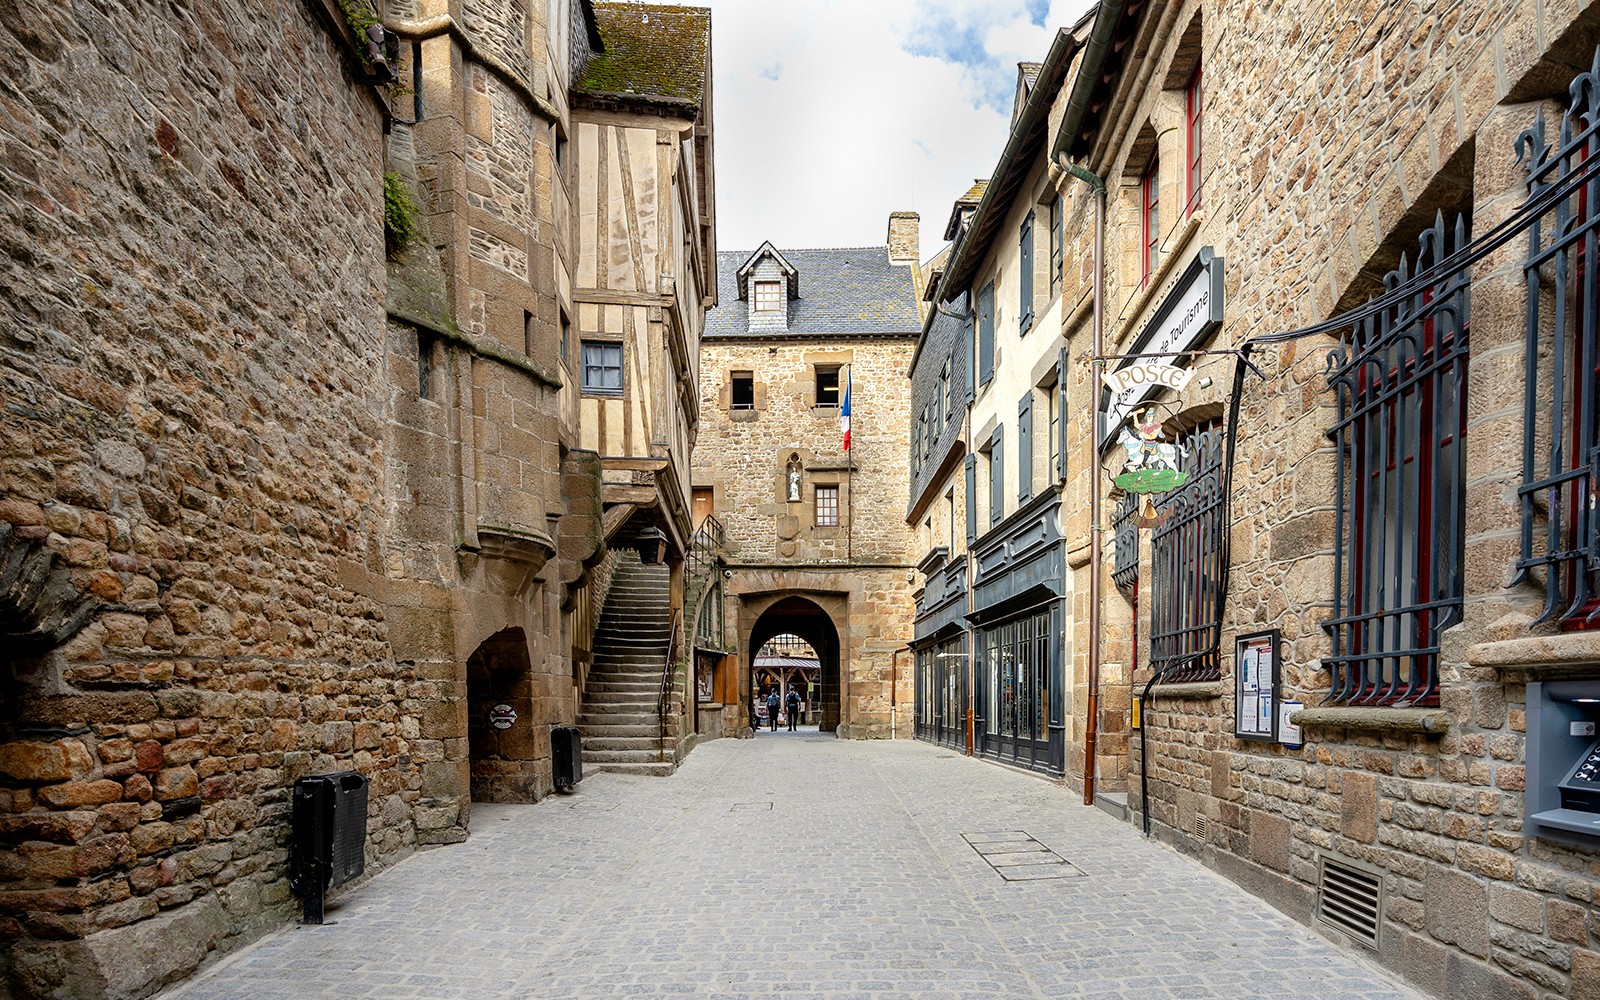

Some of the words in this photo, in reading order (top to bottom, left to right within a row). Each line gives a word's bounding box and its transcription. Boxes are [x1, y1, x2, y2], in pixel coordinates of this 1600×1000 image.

[1160, 340, 1169, 358] de
[1170, 291, 1208, 344] Tourisme
[1115, 364, 1185, 390] POSTE
